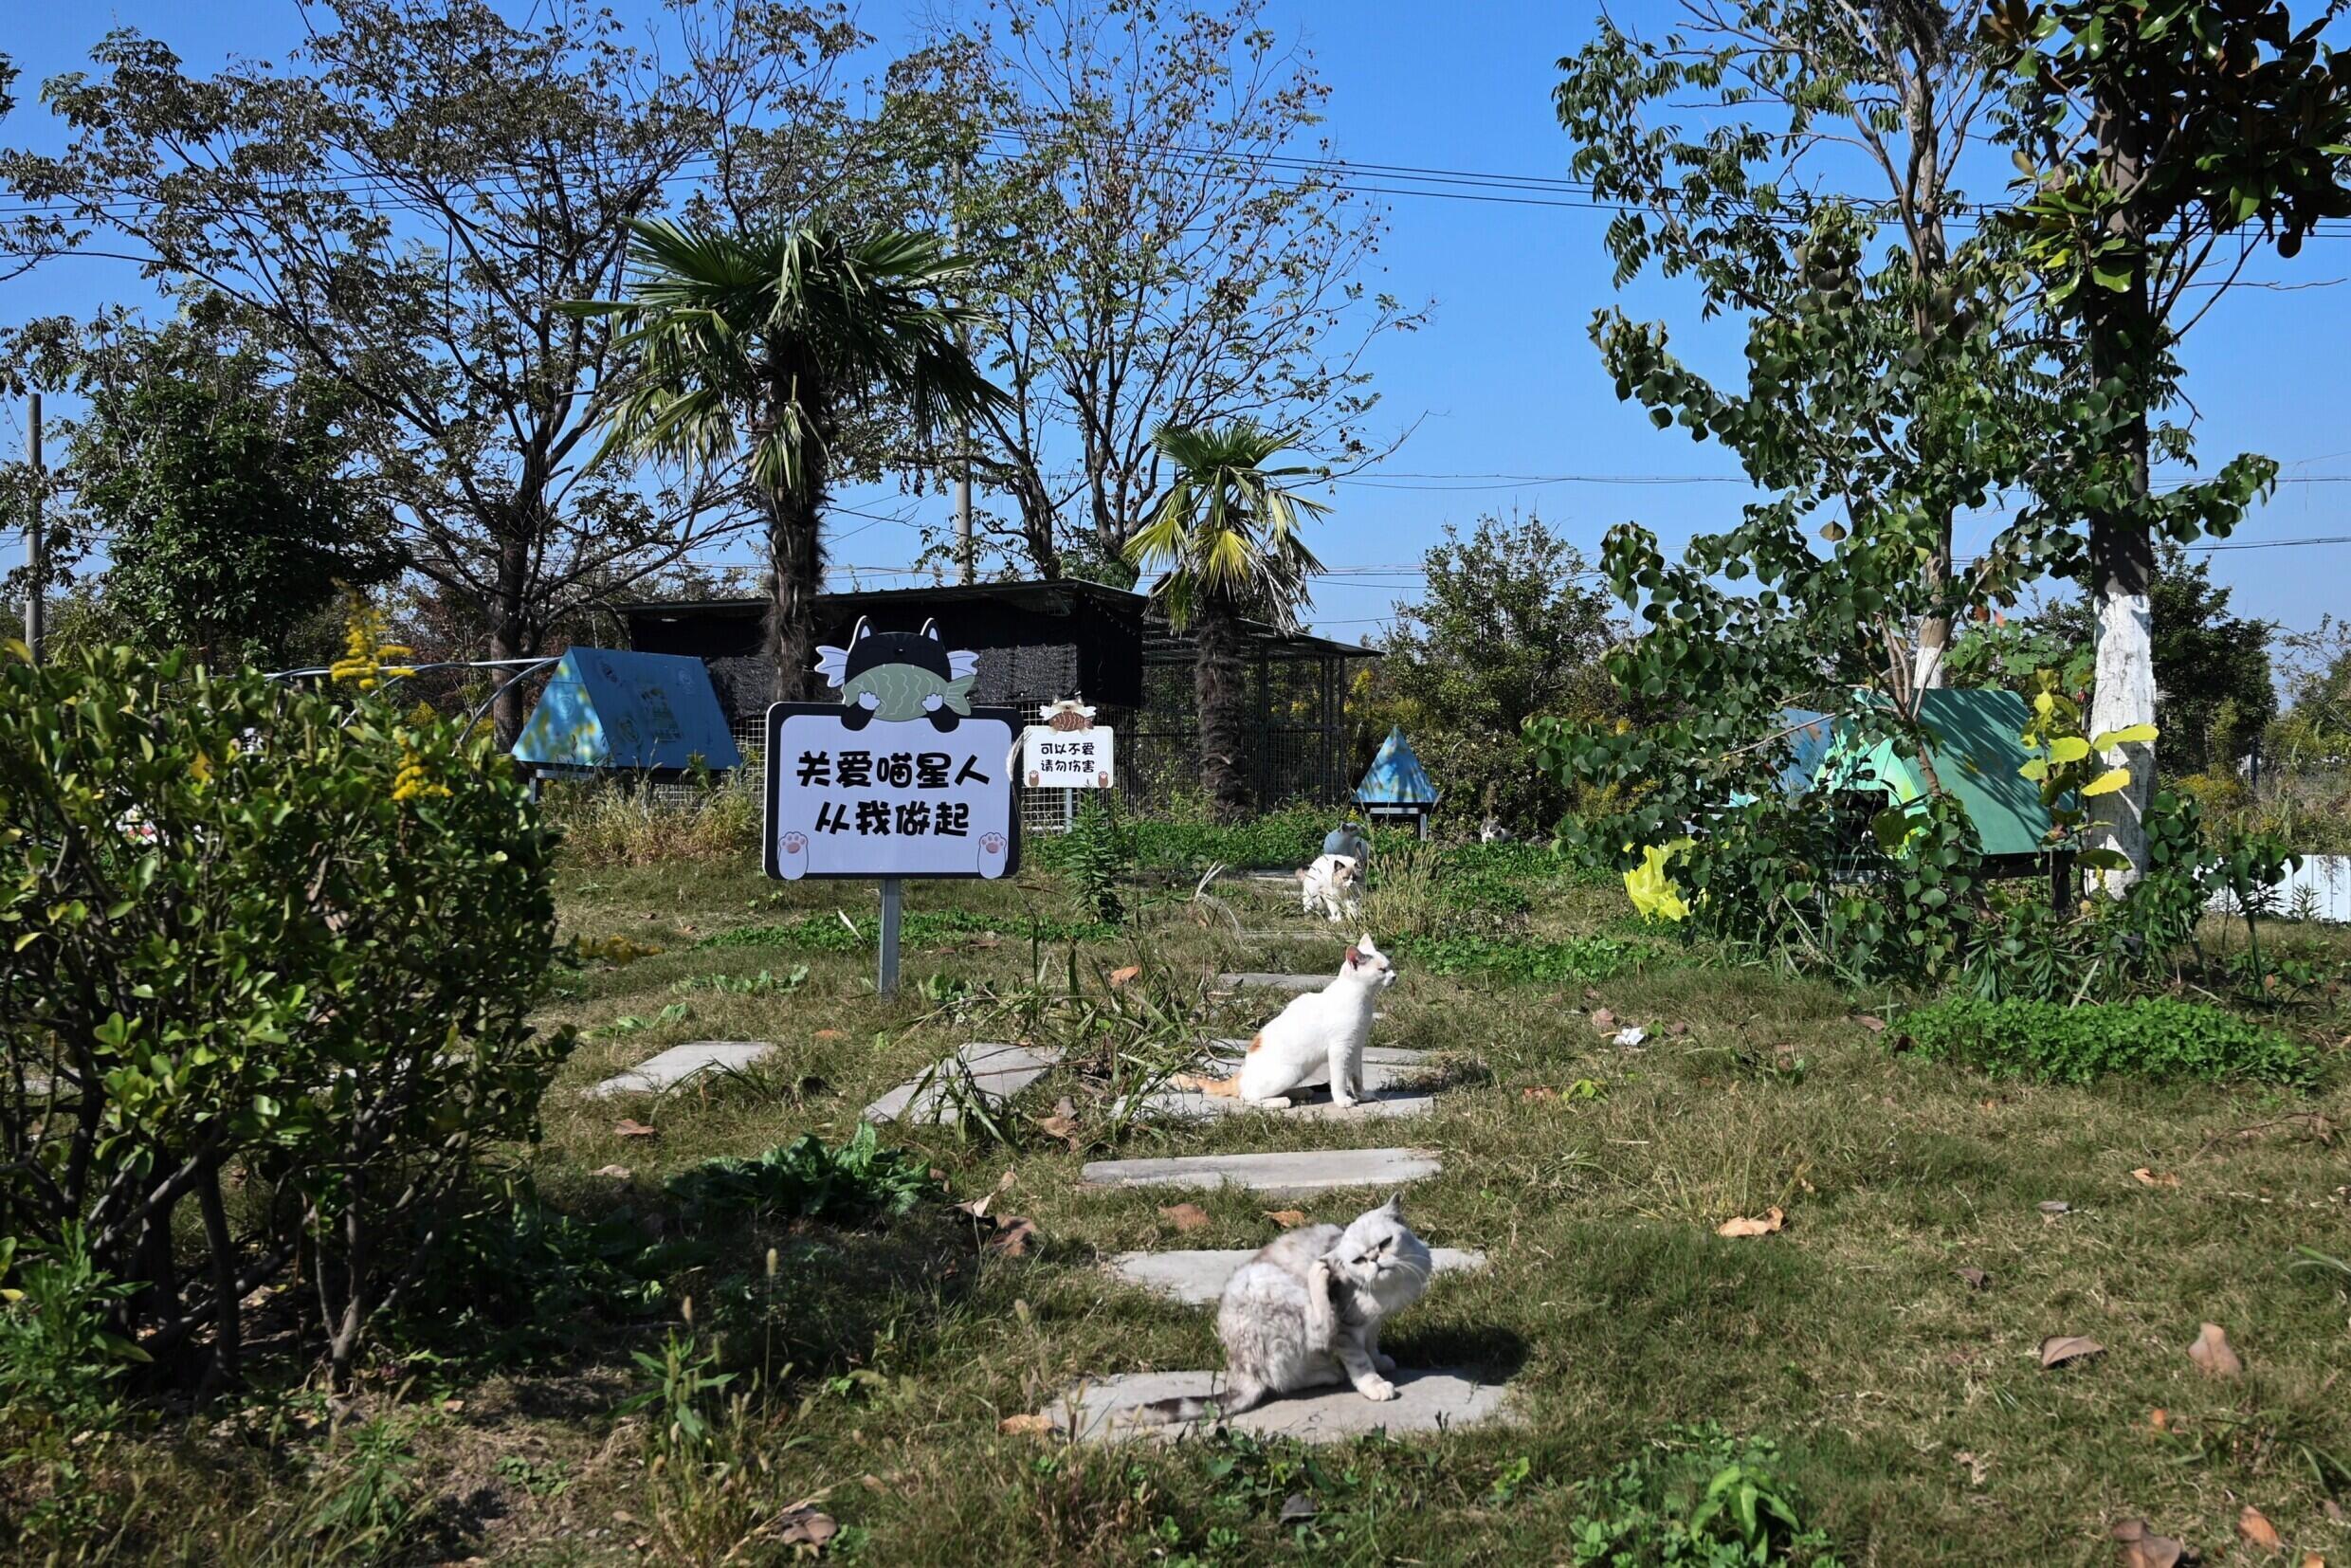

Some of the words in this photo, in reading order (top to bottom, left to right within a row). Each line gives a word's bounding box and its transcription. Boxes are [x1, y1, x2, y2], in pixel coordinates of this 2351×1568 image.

[1040, 742, 1095, 756] 可以不爱
[796, 751, 991, 789] 关爱喵星人
[1040, 759, 1095, 774] 请勿伤害
[814, 800, 971, 837] 从我做起
